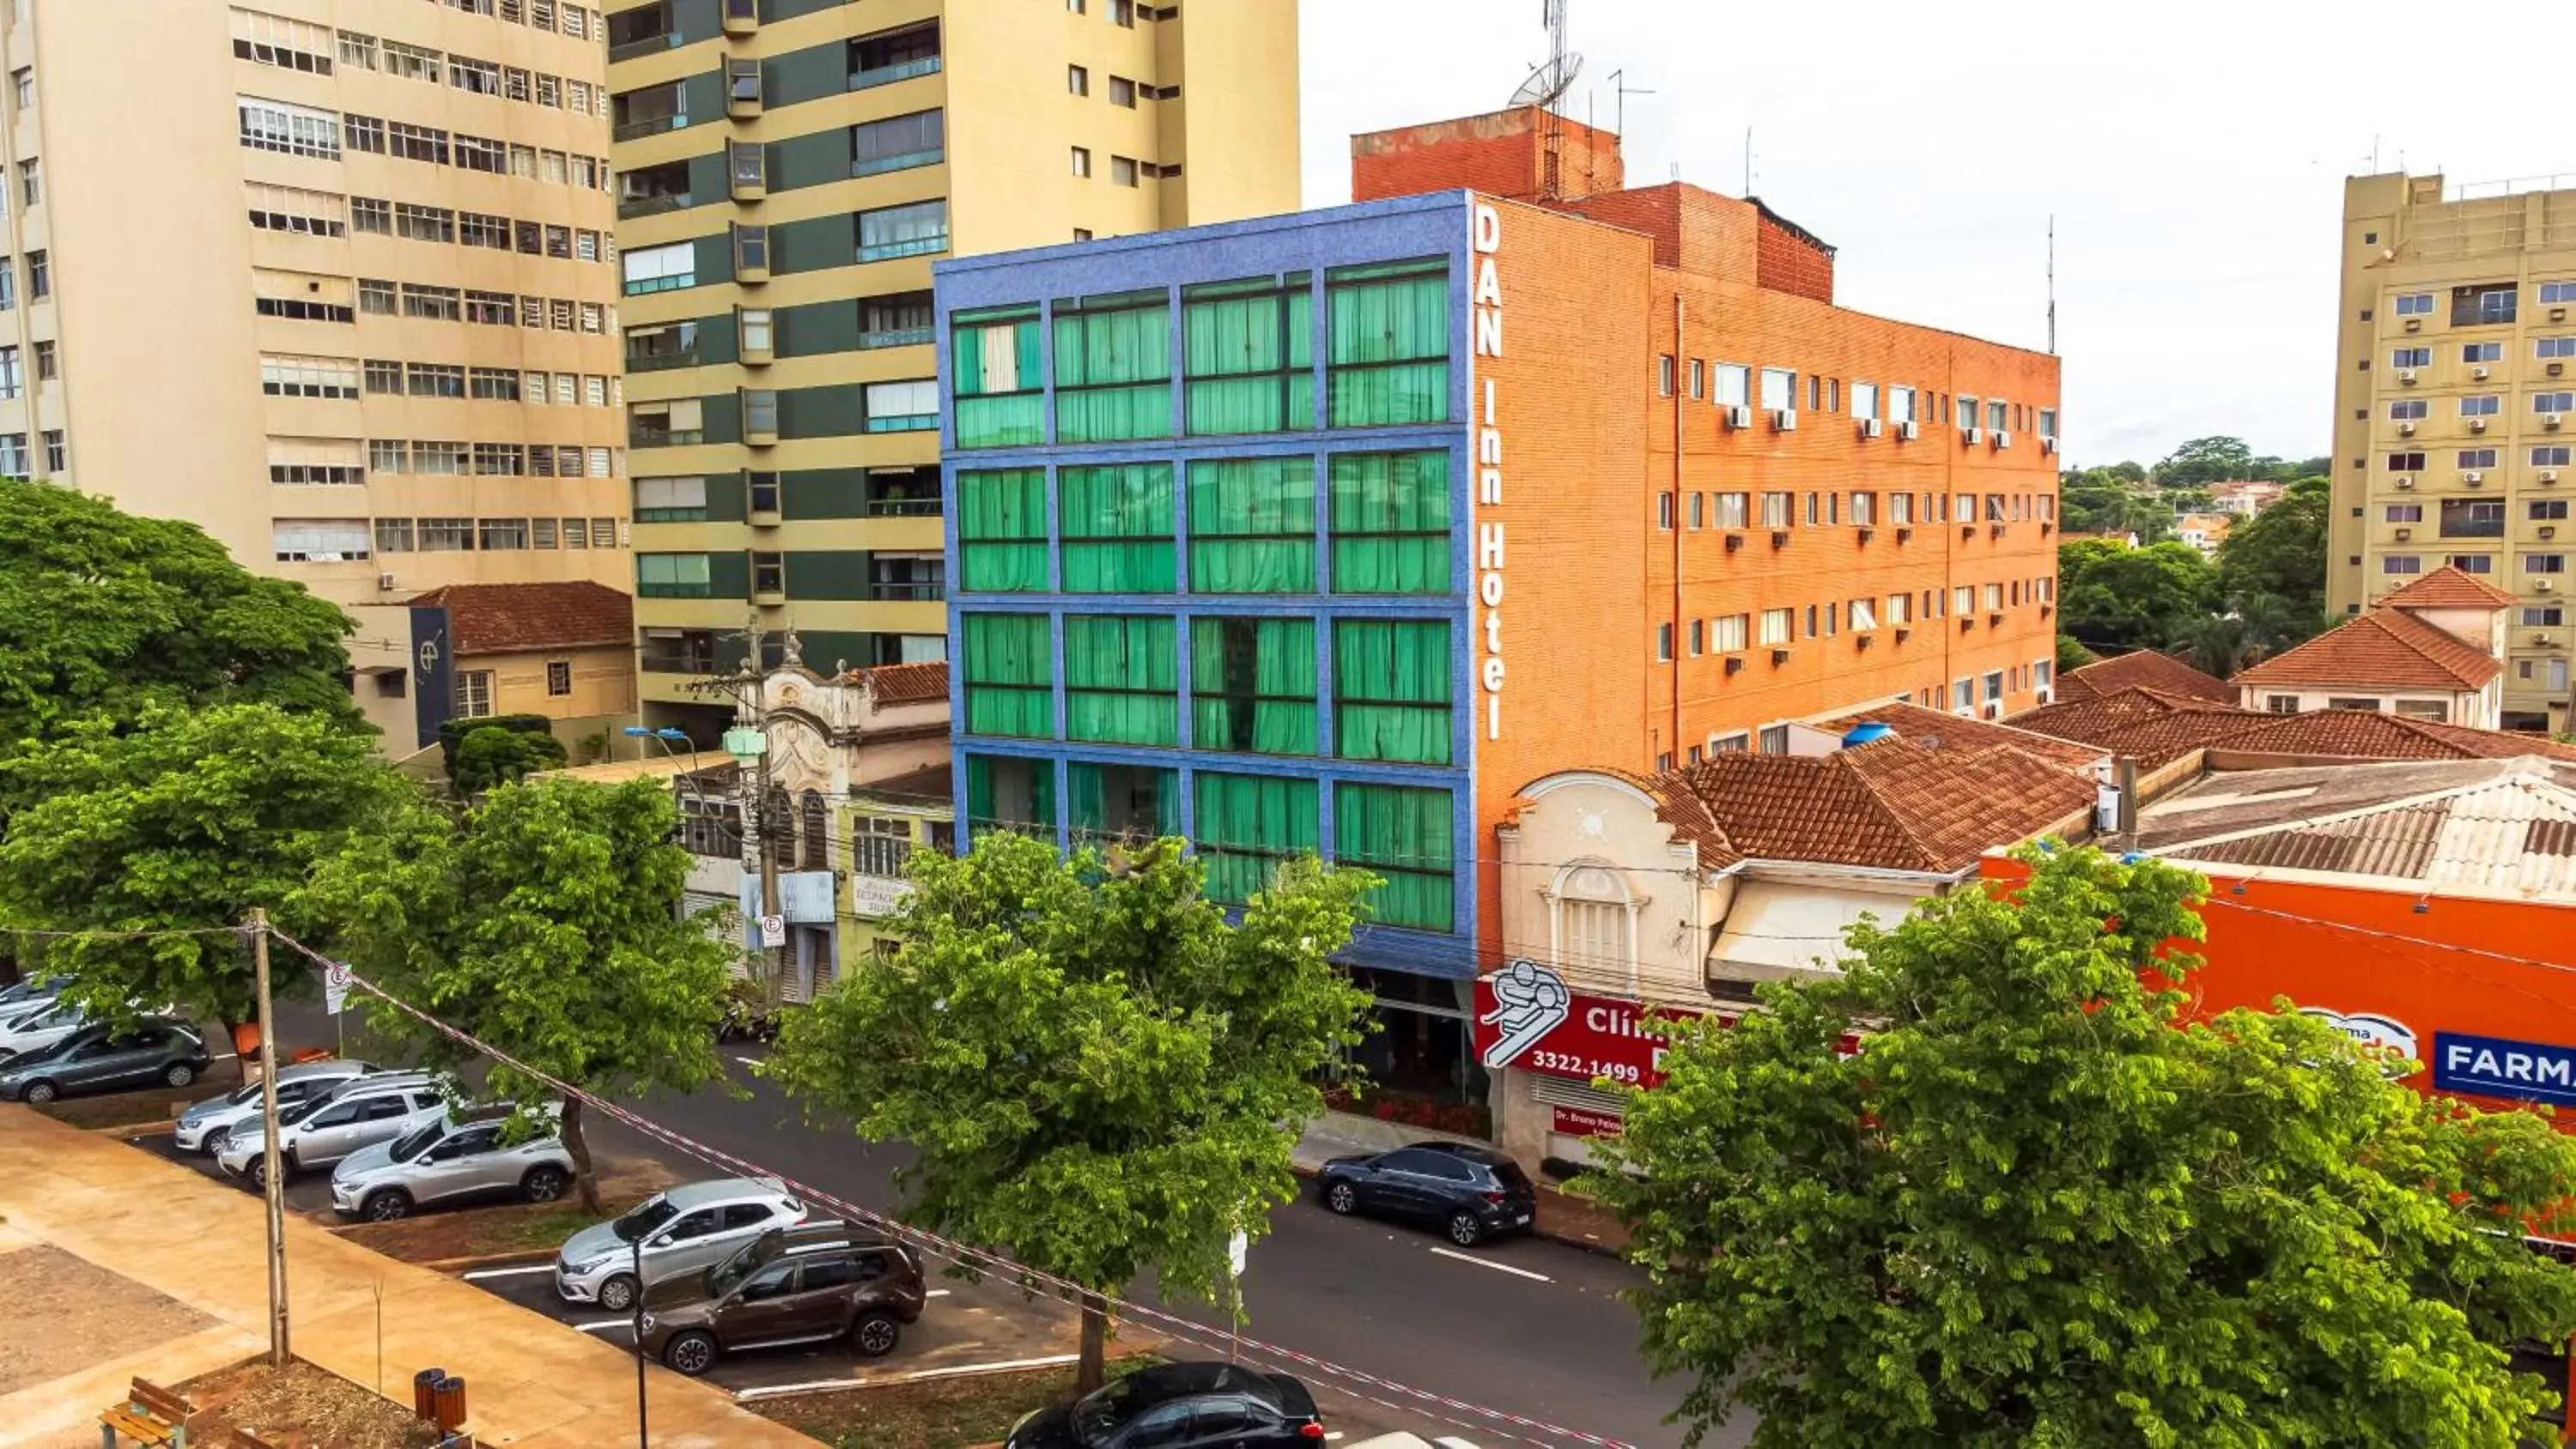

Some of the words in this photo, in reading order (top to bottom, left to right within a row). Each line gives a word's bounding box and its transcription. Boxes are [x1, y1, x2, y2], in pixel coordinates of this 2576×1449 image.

[1474, 204, 1502, 357] DAN
[1480, 378, 1502, 505] Inn
[1479, 523, 1504, 742] Hotel
[1533, 1050, 1639, 1082] 3322.1499
[2447, 1045, 2576, 1088] FARM
